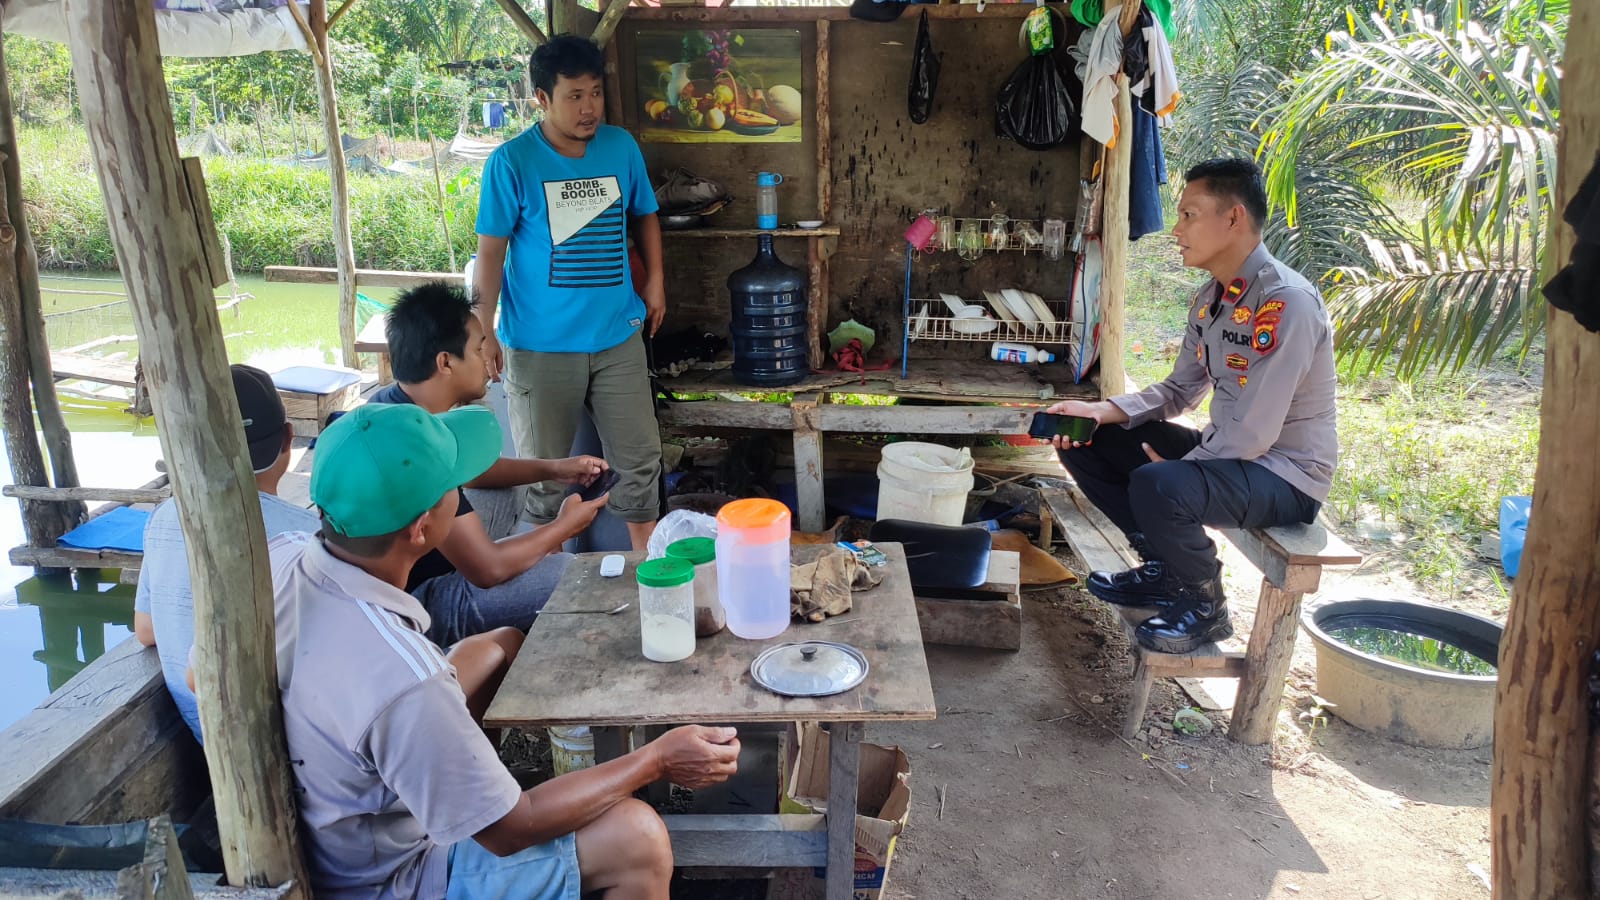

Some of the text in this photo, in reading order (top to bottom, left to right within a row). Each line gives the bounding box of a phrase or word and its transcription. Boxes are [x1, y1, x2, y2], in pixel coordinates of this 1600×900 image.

[561, 188, 607, 199] BOOGIE
[556, 200, 587, 208] BEYOND
[1222, 329, 1252, 346] POLRI
